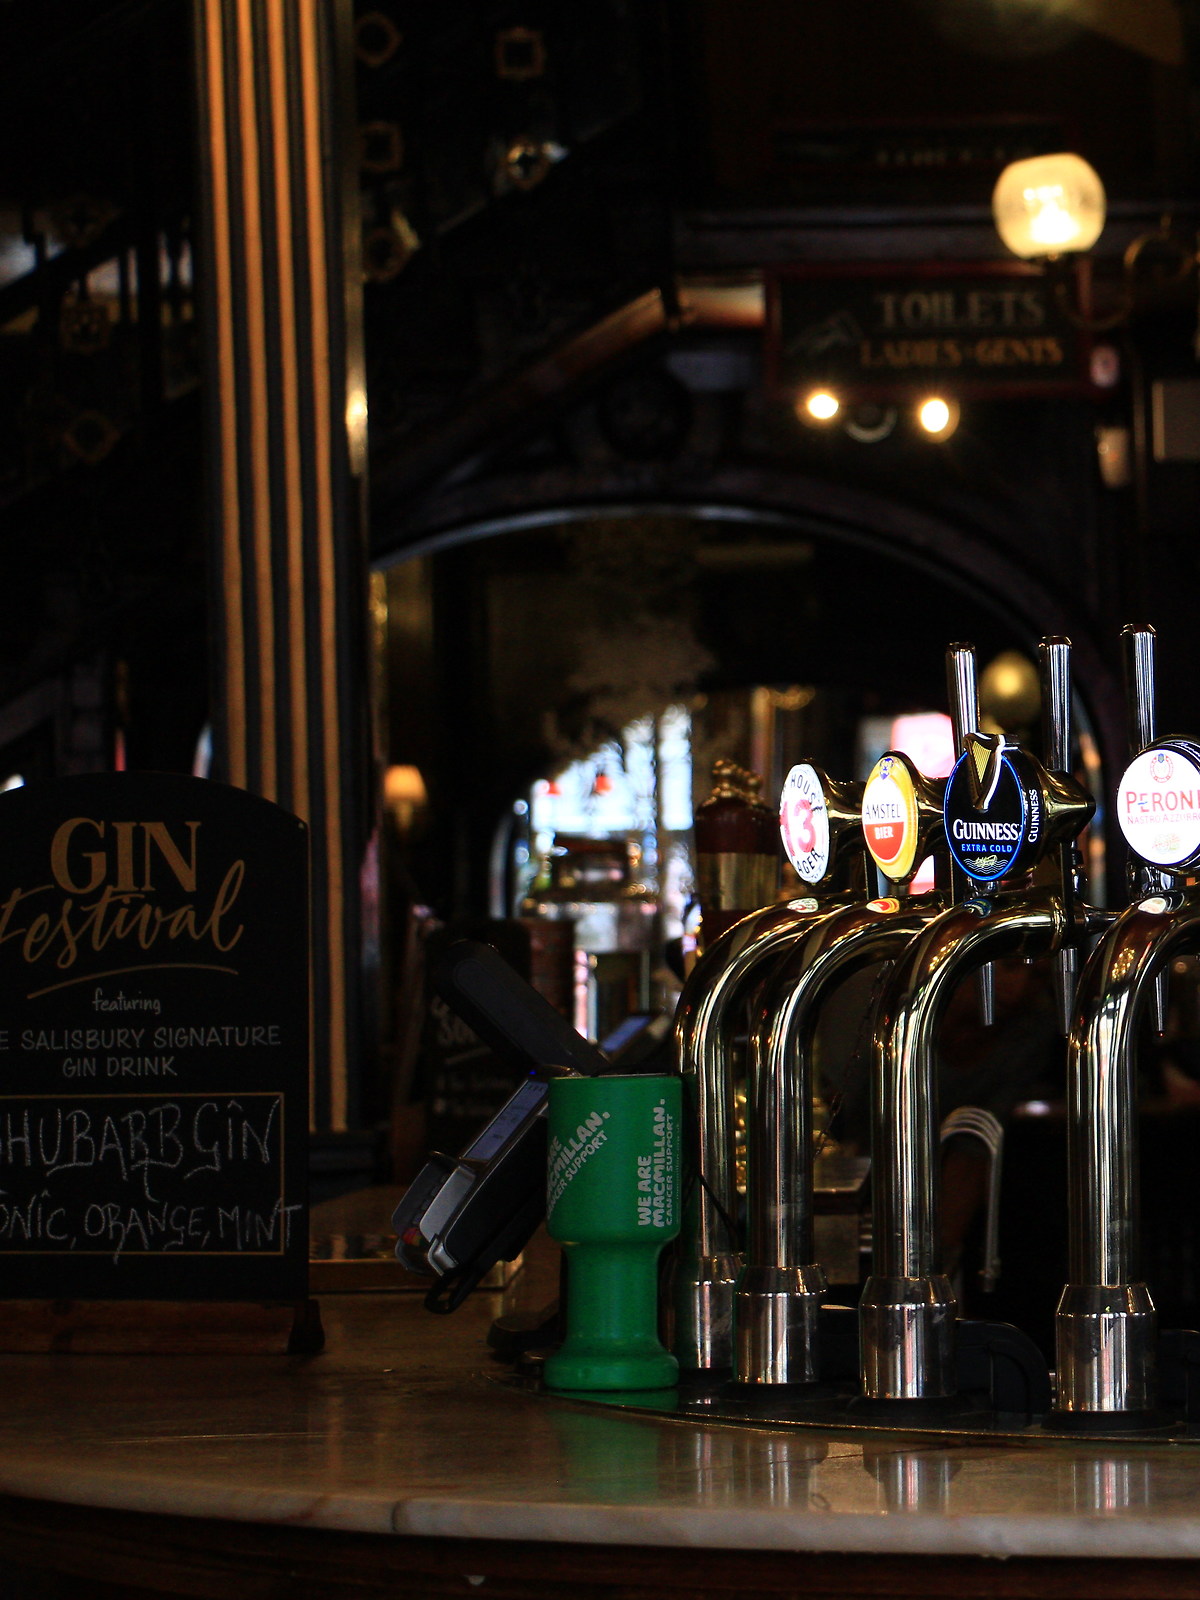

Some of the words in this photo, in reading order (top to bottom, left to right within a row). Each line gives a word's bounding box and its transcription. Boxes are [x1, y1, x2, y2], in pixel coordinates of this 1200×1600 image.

[876, 291, 1045, 327] TOILETS
[865, 803, 901, 820] AMSTEL
[1027, 789, 1040, 843] GUINNESS
[1127, 814, 1161, 825] NASTRO
[874, 826, 894, 840] BIER
[953, 819, 1019, 841] GUINNESS
[51, 817, 202, 894] GIN
[797, 846, 822, 875] AGER
[961, 843, 987, 852] EXTRA
[990, 844, 1013, 853] COLD
[92, 986, 162, 1015] featuring
[21, 1028, 145, 1051] SALISBURY
[153, 1024, 282, 1049] SIGNATURE
[62, 1056, 97, 1078] GIN
[106, 1055, 178, 1077] DRINK
[0, 1103, 184, 1202] HUBARB
[565, 1130, 609, 1181] SUPPORT
[666, 1113, 674, 1172] SUPPORT
[637, 1155, 652, 1192] ARE
[217, 1196, 303, 1250] MINT
[637, 1196, 652, 1226] WE
